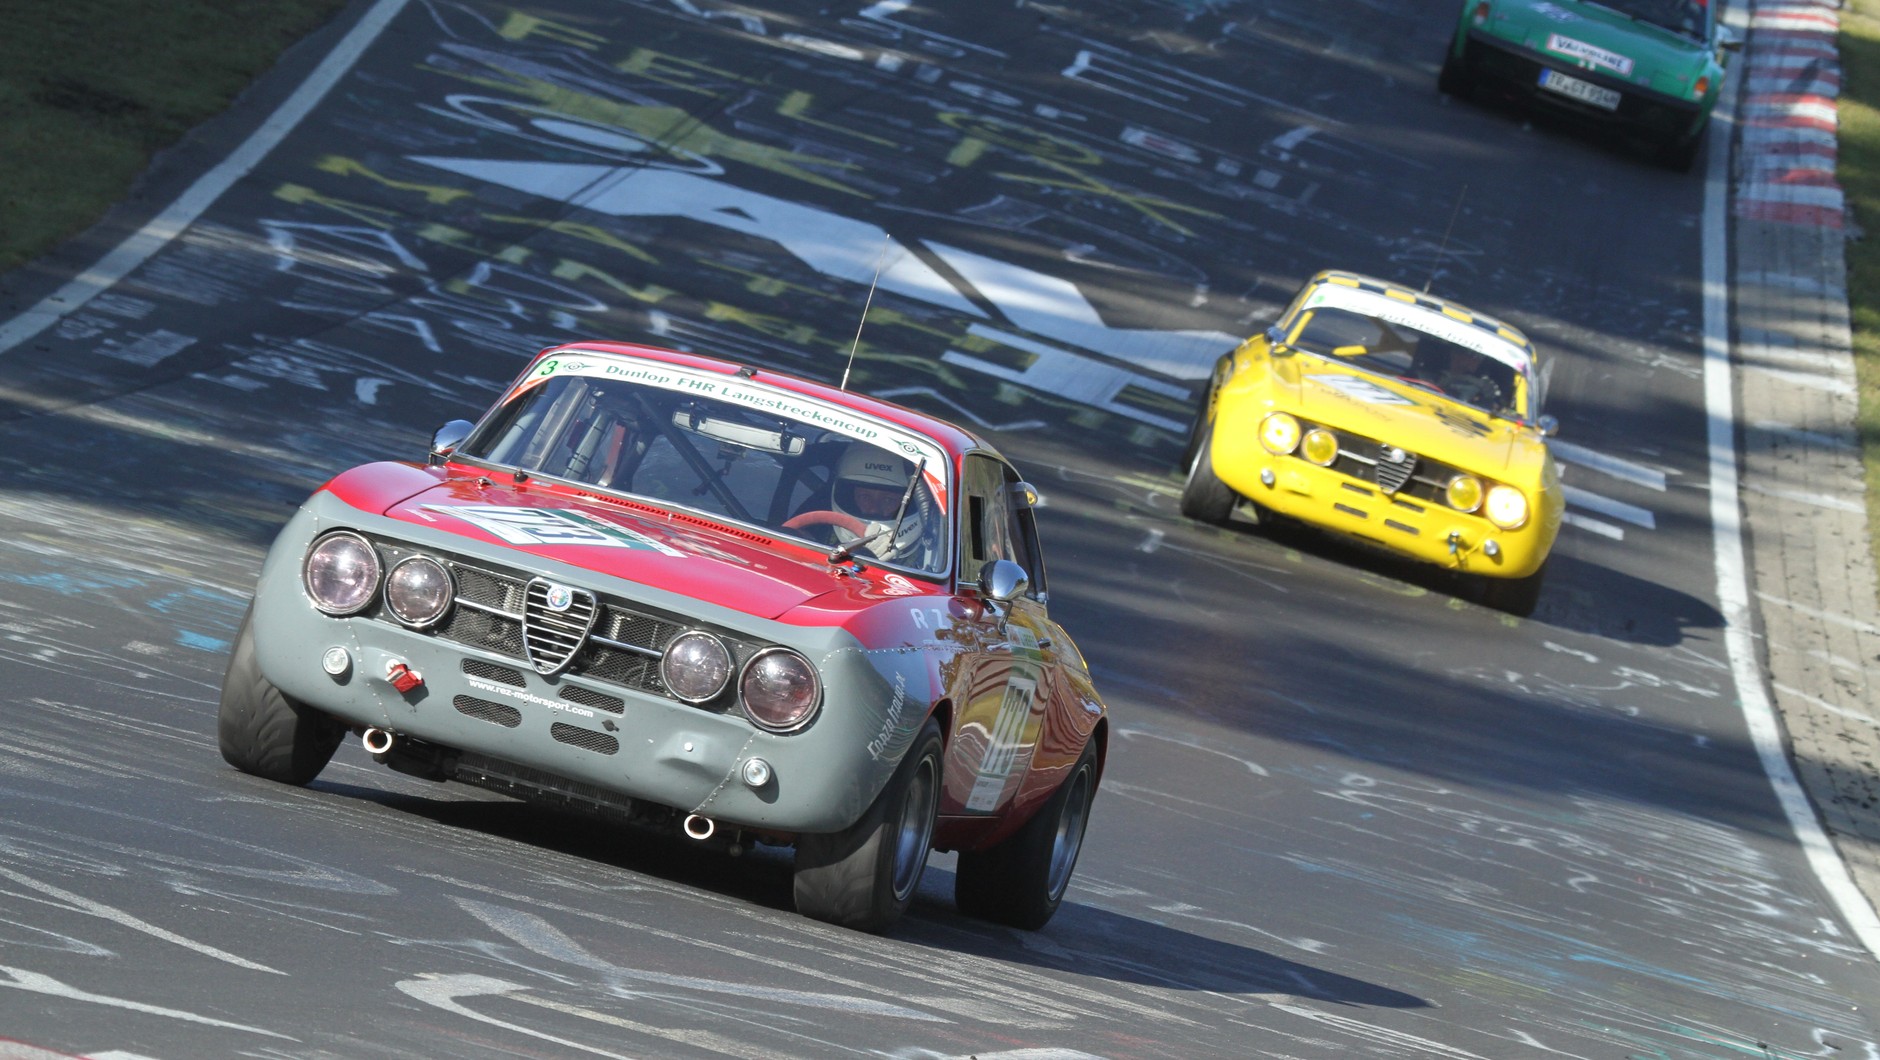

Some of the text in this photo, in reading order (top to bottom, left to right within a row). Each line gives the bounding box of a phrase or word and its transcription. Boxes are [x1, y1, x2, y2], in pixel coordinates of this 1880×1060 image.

[541, 361, 559, 376] 3
[605, 365, 879, 440] Dunlop FHR Langstreckencup
[864, 462, 893, 472] uvex
[897, 520, 918, 538] uvex
[469, 680, 594, 718] www.rez-motorsport.com
